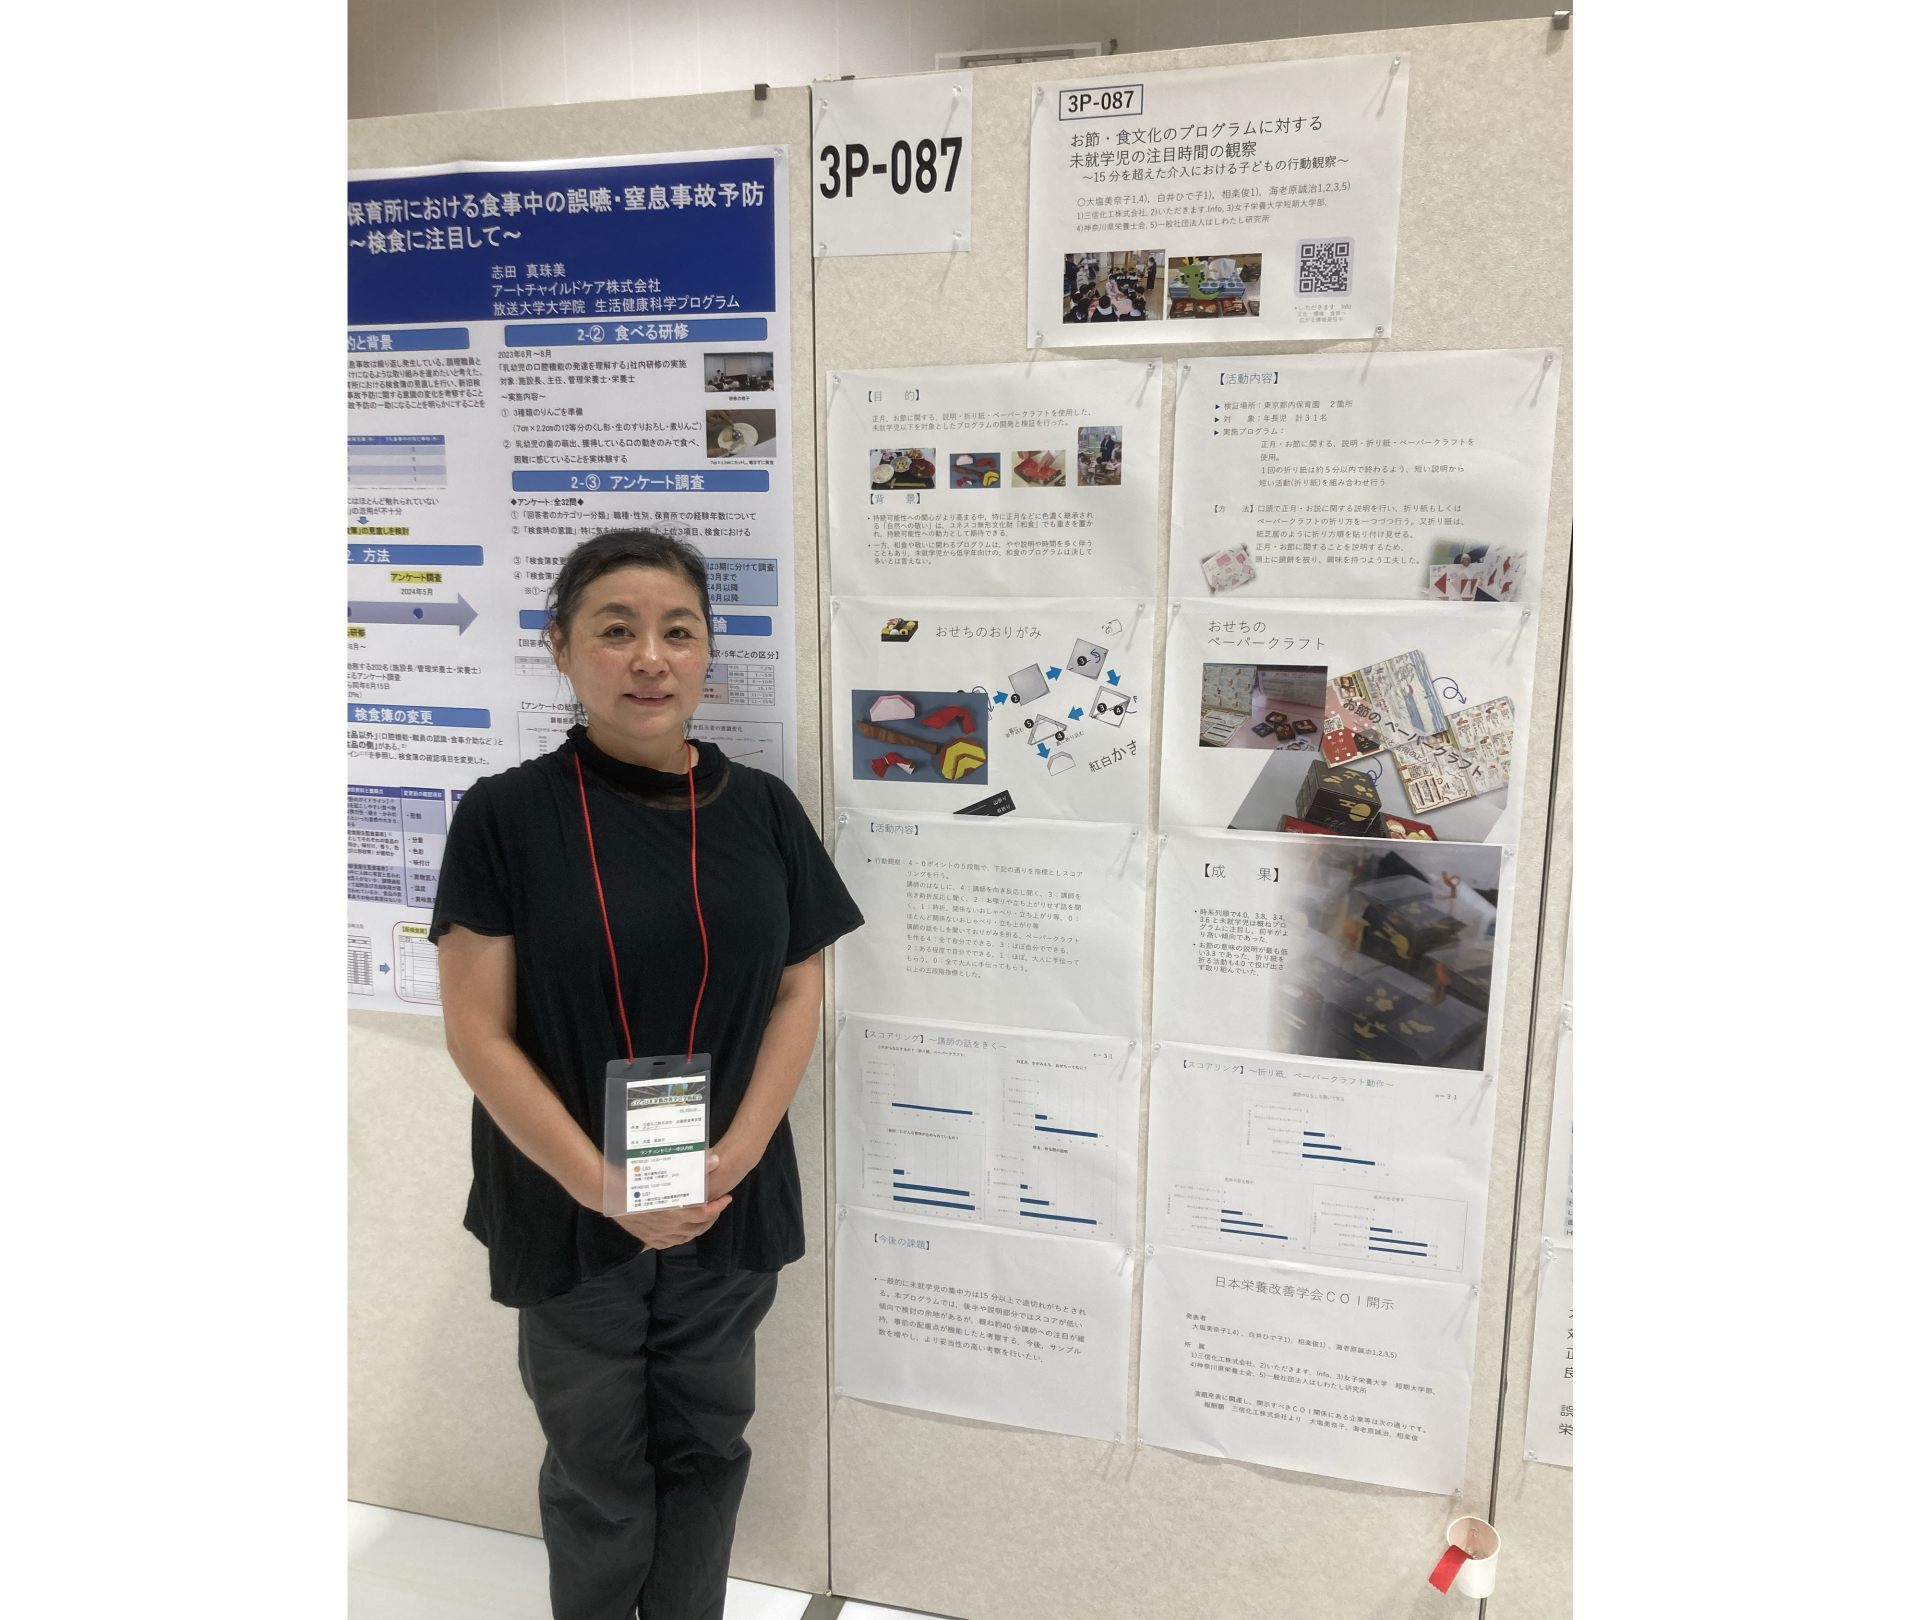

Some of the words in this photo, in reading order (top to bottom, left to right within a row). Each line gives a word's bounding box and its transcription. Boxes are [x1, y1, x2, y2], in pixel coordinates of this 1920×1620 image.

[1067, 90, 1134, 113] 3P-087
[1070, 115, 1323, 148] お節・食文化のプログラムに対する
[1069, 140, 1257, 169] 未就学児の注目時間の観察
[819, 136, 962, 199] 3P-087
[349, 225, 521, 255] ～検食に注目して～
[491, 265, 517, 279] 志田
[526, 262, 566, 278] 真珠美
[492, 278, 661, 297] アートチャイルドケア株式会社
[493, 299, 586, 316] 放送大学大学院
[595, 294, 740, 312] 生活健康科学プログラム
[615, 324, 689, 341] 食べる研修
[1219, 372, 1279, 386] 【活動内容】
[610, 474, 705, 490] アンケート調査
[363, 548, 391, 563] 方法
[391, 572, 442, 583] アンケート調査
[935, 625, 1042, 639] おせちのおりがみ
[1208, 620, 1266, 633] おせちの
[1207, 636, 1325, 651] ペーパークラフト
[355, 707, 434, 725] 検食簿の変更
[870, 822, 919, 836] 【活動内容】
[874, 1233, 930, 1251] 【今後の課題】
[1215, 1275, 1396, 1311] 日本栄養改善学会ＣＯＩ開示
